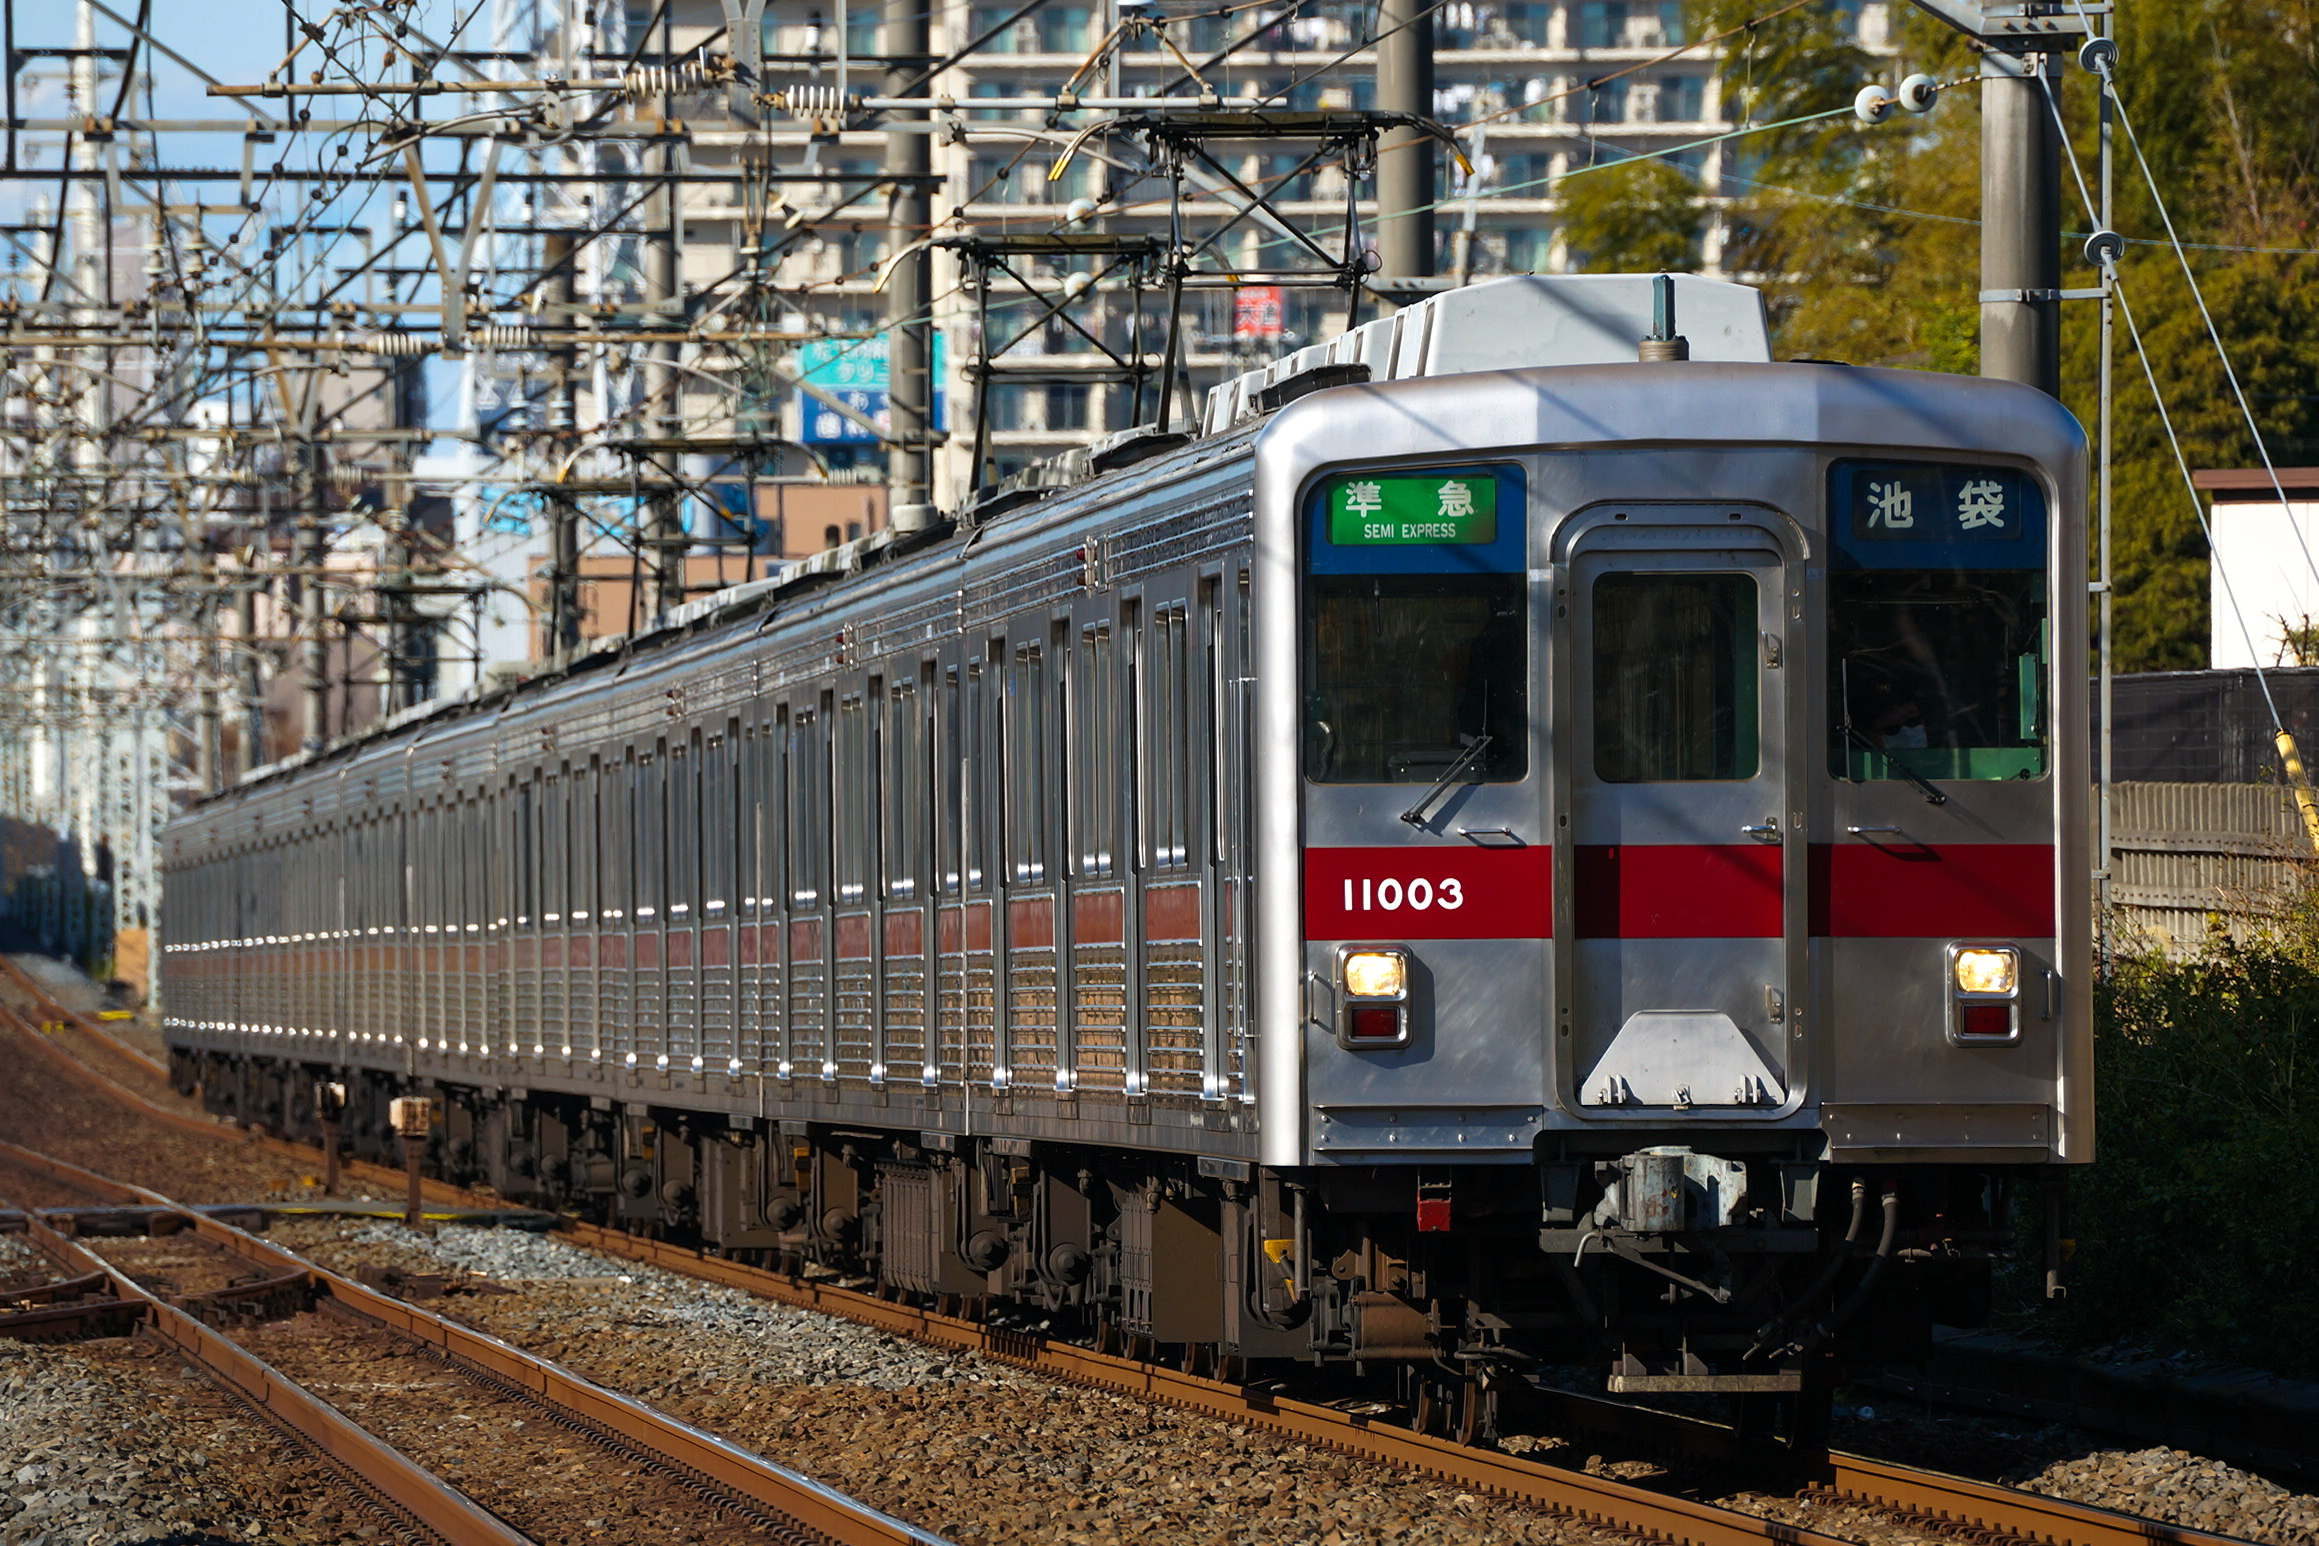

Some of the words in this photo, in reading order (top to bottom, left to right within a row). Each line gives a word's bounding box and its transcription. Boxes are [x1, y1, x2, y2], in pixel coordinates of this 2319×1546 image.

[1363, 523, 1395, 539] SEMI
[1401, 522, 1456, 538] EXPRESS
[1344, 877, 1464, 911] 11003
